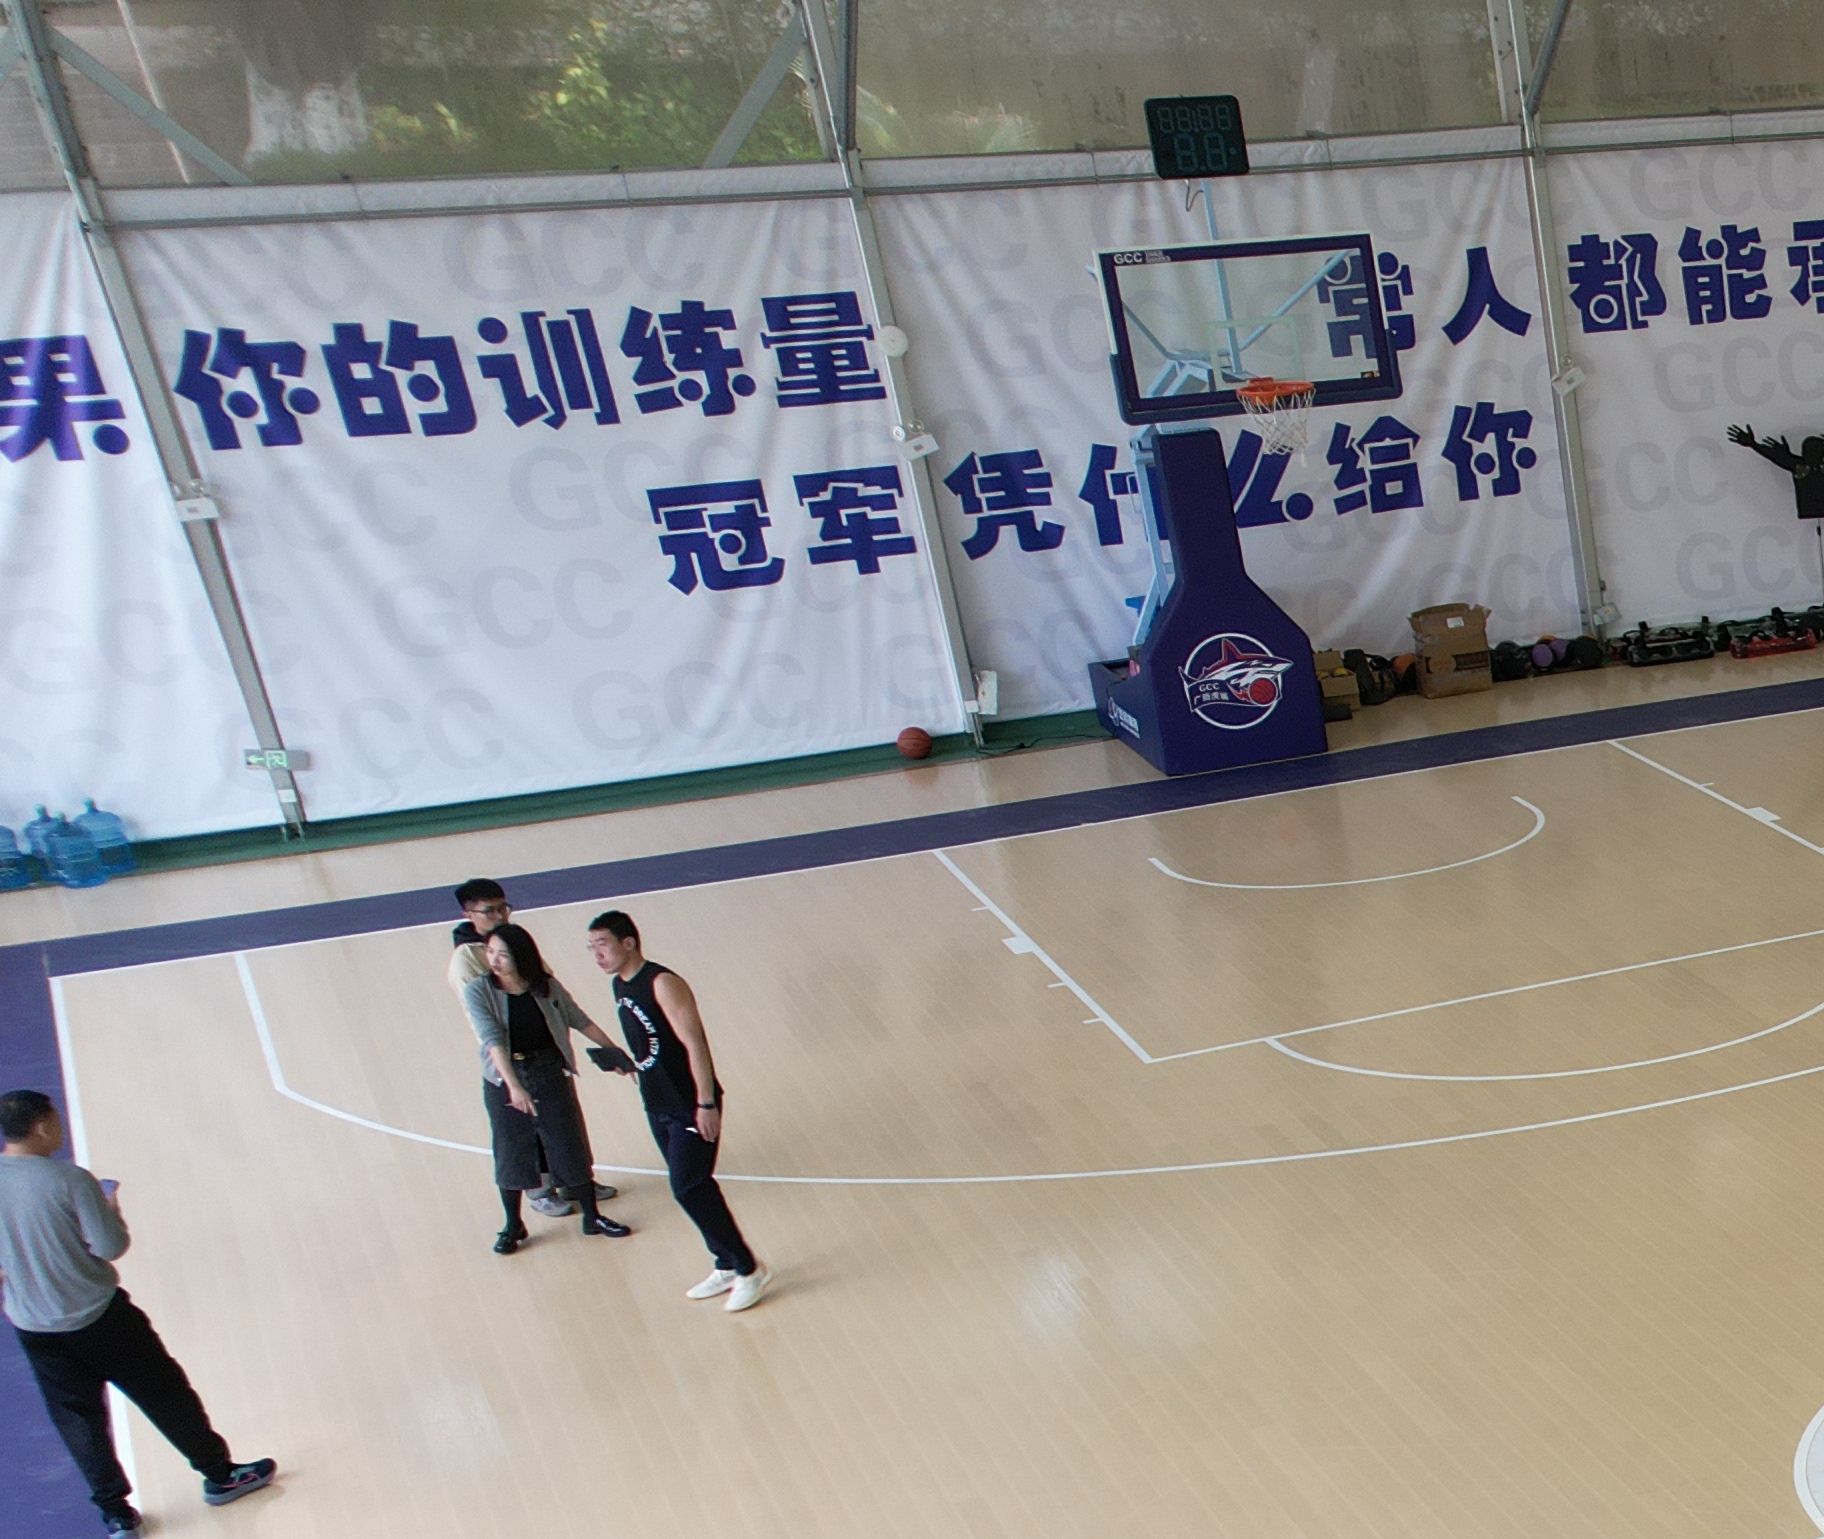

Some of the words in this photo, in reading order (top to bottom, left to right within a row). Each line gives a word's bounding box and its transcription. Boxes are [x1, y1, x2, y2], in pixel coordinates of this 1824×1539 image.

[1630, 140, 1811, 219] GCC
[1113, 252, 1143, 265] GCC
[372, 557, 635, 658] GCC
[571, 651, 803, 750] GCC
[1199, 682, 1220, 692] GCC
